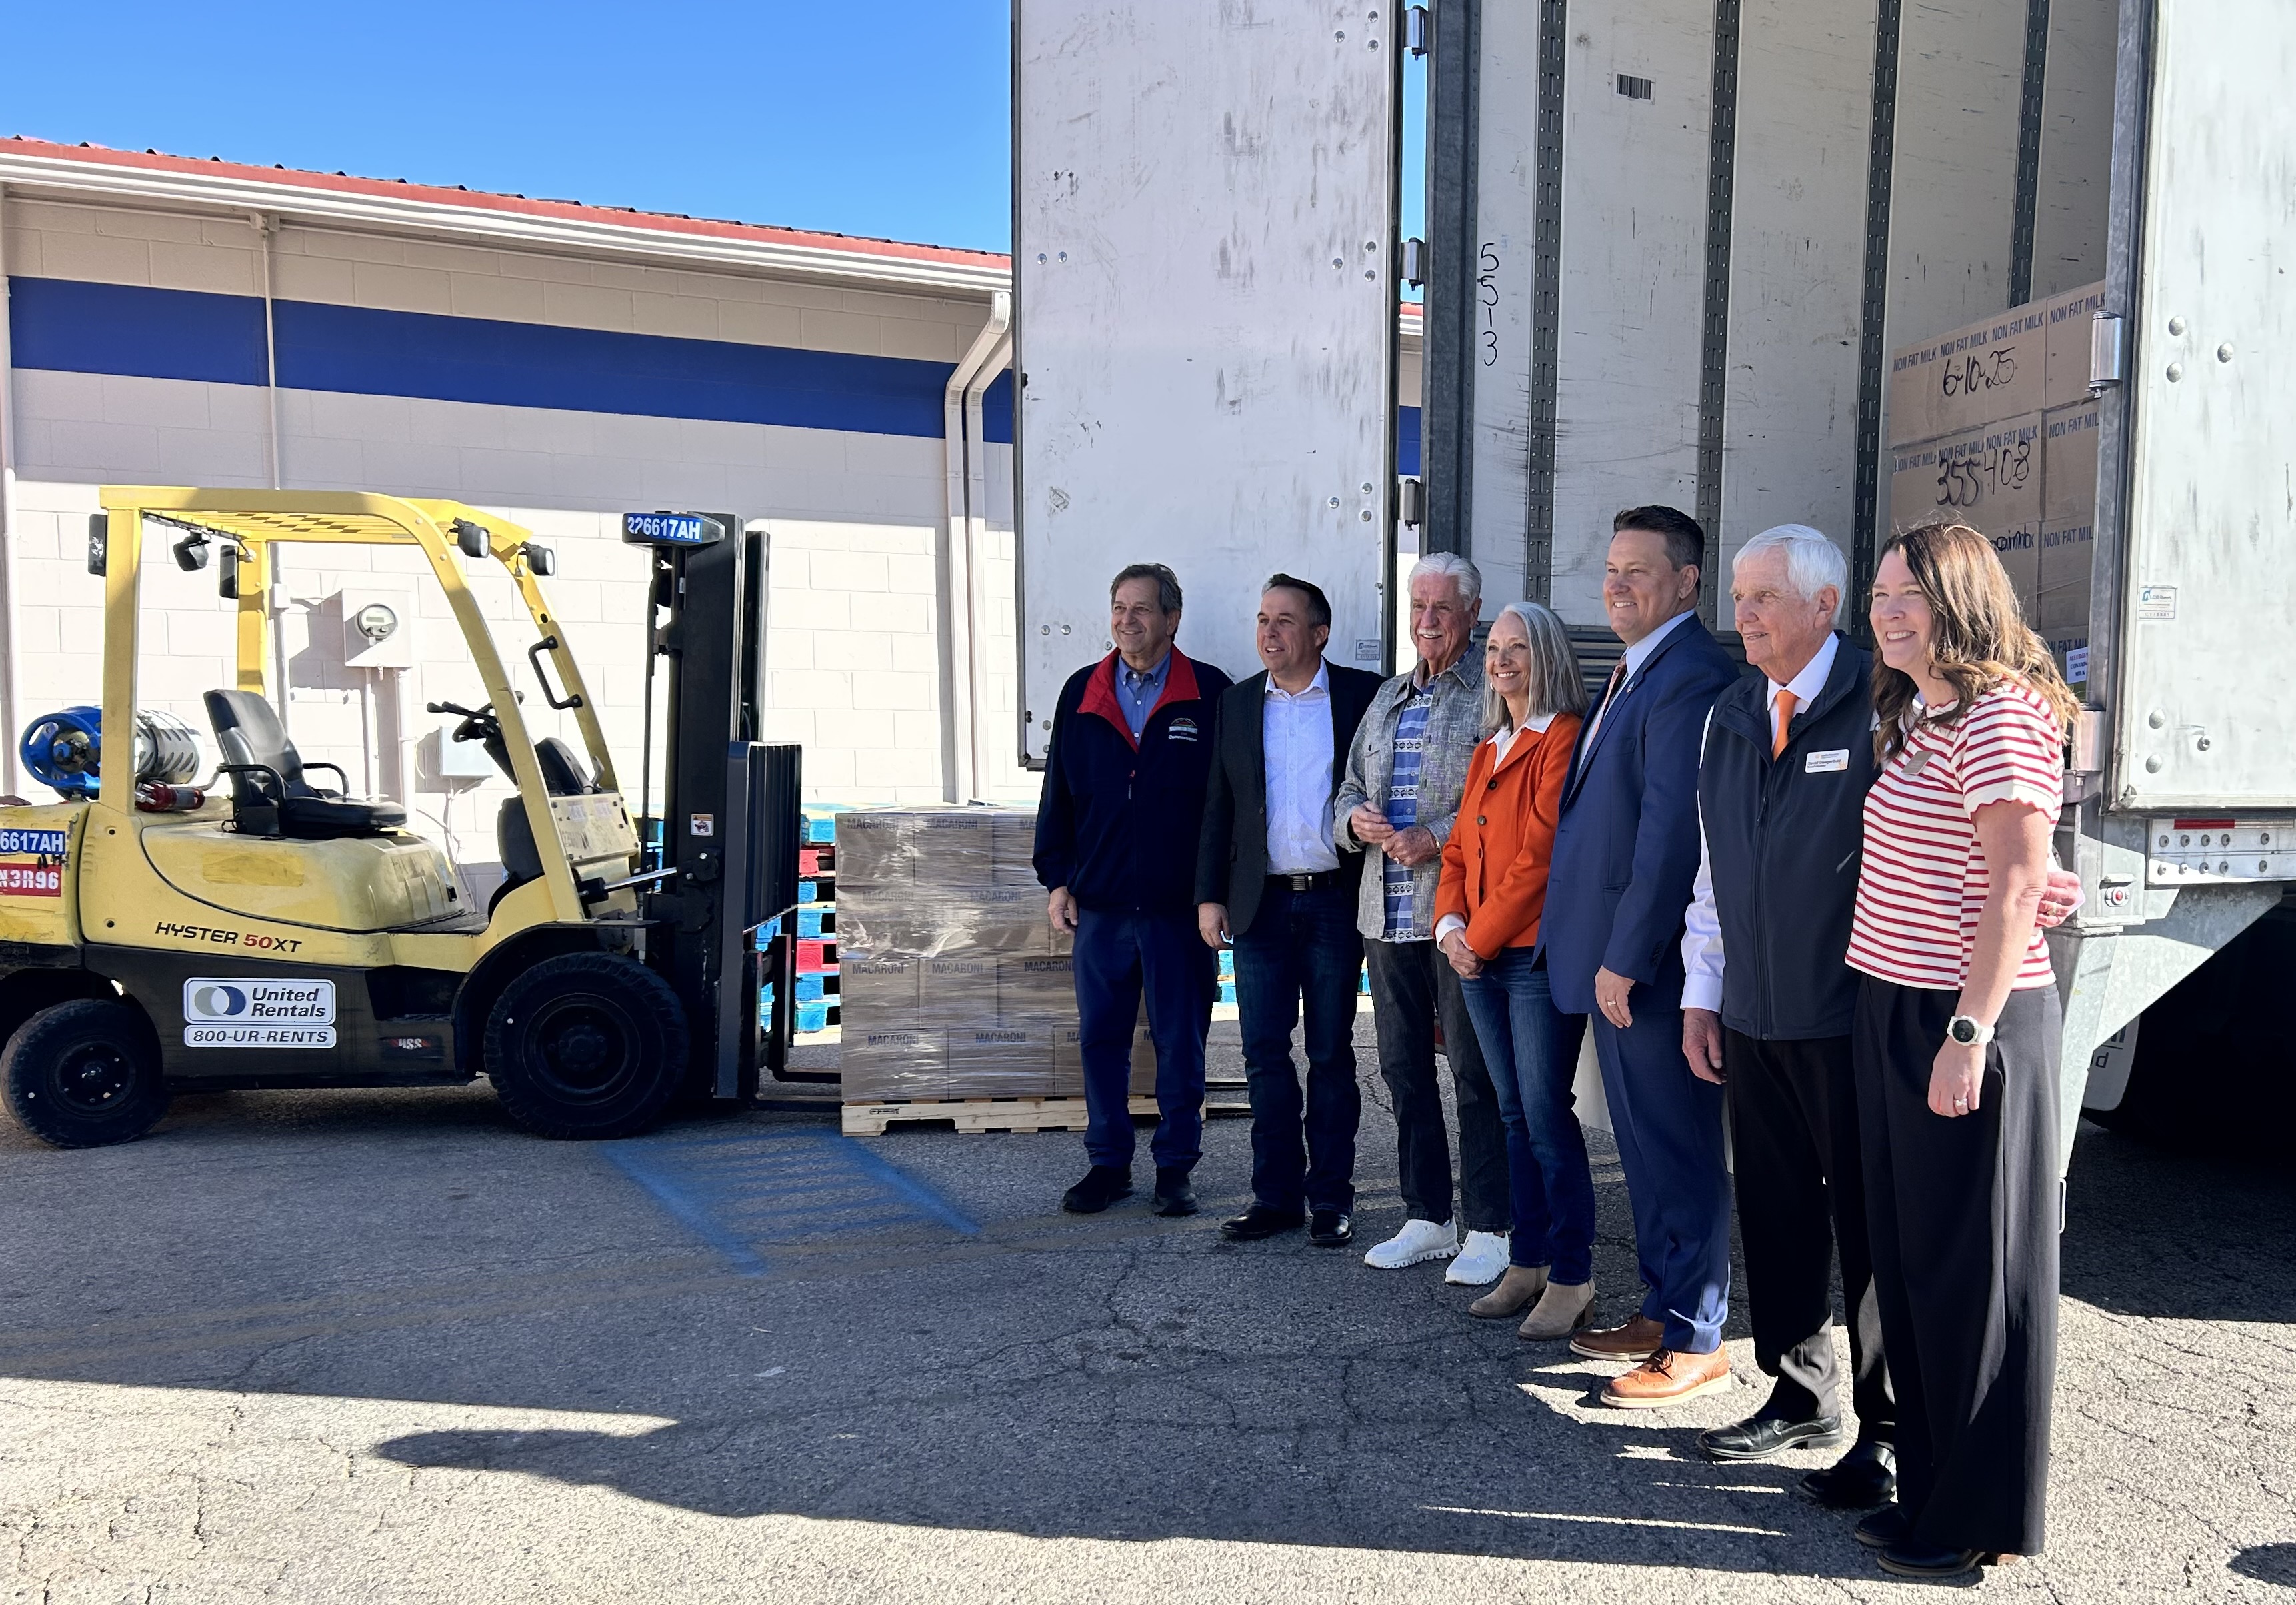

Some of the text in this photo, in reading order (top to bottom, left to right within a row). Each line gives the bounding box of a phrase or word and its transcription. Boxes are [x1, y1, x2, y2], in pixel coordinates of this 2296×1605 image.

[2049, 291, 2106, 325] NON FAT MILK
[1991, 311, 2044, 342] NON FAT MILK
[1940, 331, 1988, 358] NON FAT MILK
[1894, 347, 1937, 373] NON FAT MILK
[2049, 411, 2099, 438] NON FAT MIL
[1987, 425, 2037, 450] NON FAT MILK
[1909, 454, 1921, 469] FAT
[1939, 447, 1953, 463] NON
[1955, 443, 1968, 459] FAT
[627, 517, 700, 539] 226617AH
[2044, 525, 2093, 548] NON FAT MIL
[2058, 639, 2072, 654] FAT
[2074, 638, 2087, 650] MIL
[0, 832, 63, 852] 6617AH
[155, 922, 302, 952] HYSTER 50XT
[853, 963, 905, 974] MACARONI
[932, 963, 983, 974] MACARONI
[252, 987, 319, 1002] United
[251, 1003, 325, 1017] Rentals
[193, 1030, 328, 1043] 800-UR-RENTS
[976, 1032, 1026, 1043] MACARONI
